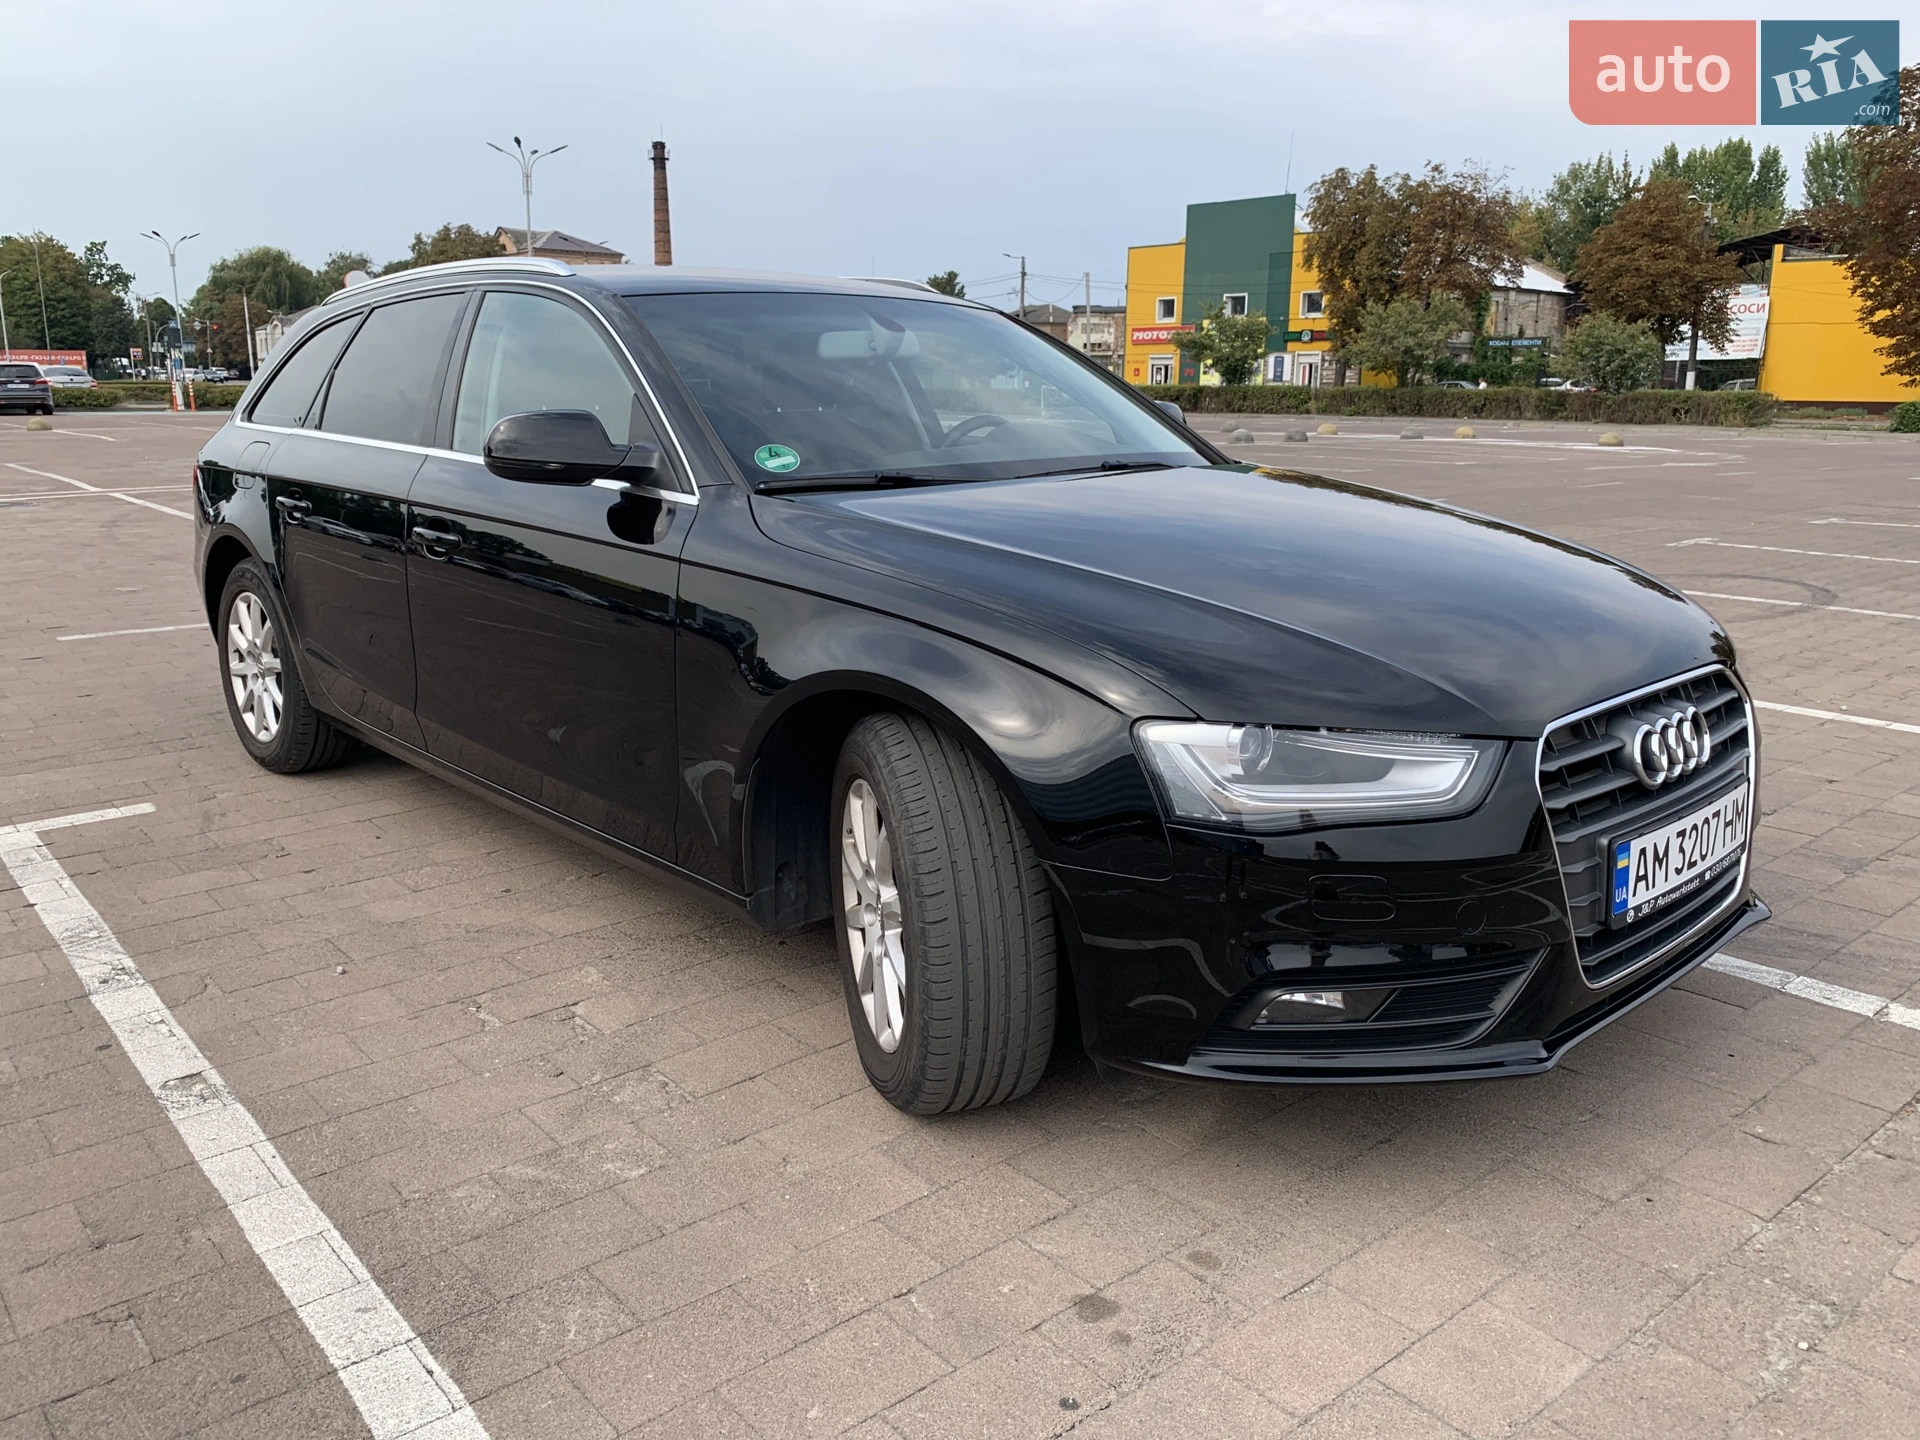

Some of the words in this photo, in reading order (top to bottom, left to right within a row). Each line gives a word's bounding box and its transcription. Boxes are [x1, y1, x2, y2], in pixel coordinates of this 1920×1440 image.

[1729, 302, 1766, 315] СОСИ
[768, 447, 781, 458] 4
[1632, 836, 1670, 898] AM
[1674, 809, 1721, 876] 3207
[1722, 791, 1746, 849] HM
[1615, 887, 1627, 903] UA
[1656, 878, 1700, 908] Autowerkstatt
